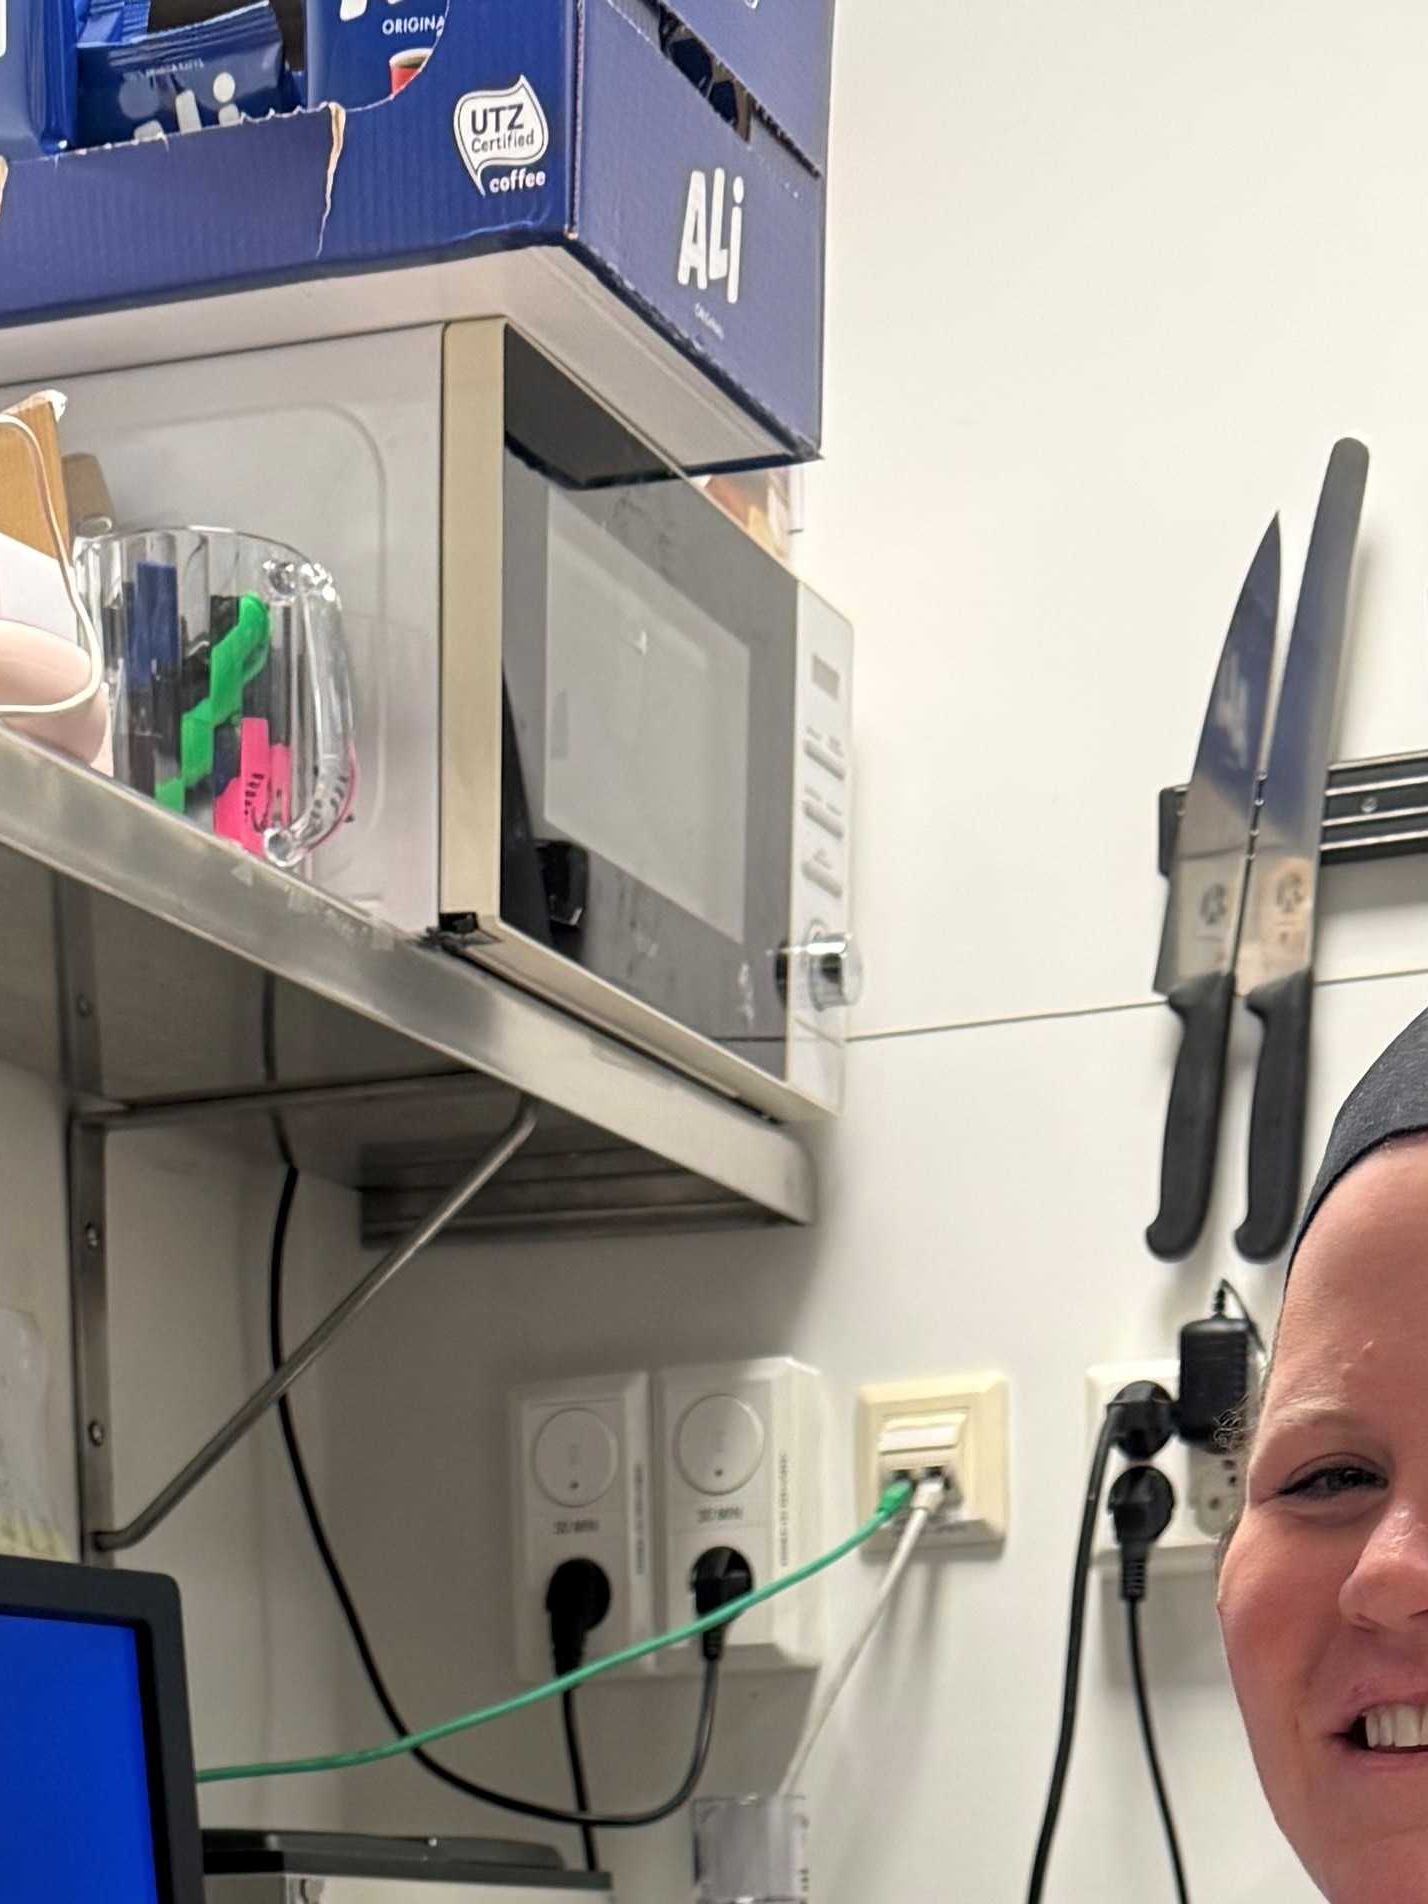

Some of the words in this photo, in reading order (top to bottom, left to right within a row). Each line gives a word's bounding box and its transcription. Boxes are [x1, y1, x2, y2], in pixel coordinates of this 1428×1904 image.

[382, 16, 446, 36] ORIGINA
[472, 105, 524, 135] UTZ
[472, 132, 535, 153] Certified
[490, 169, 546, 193] coffee
